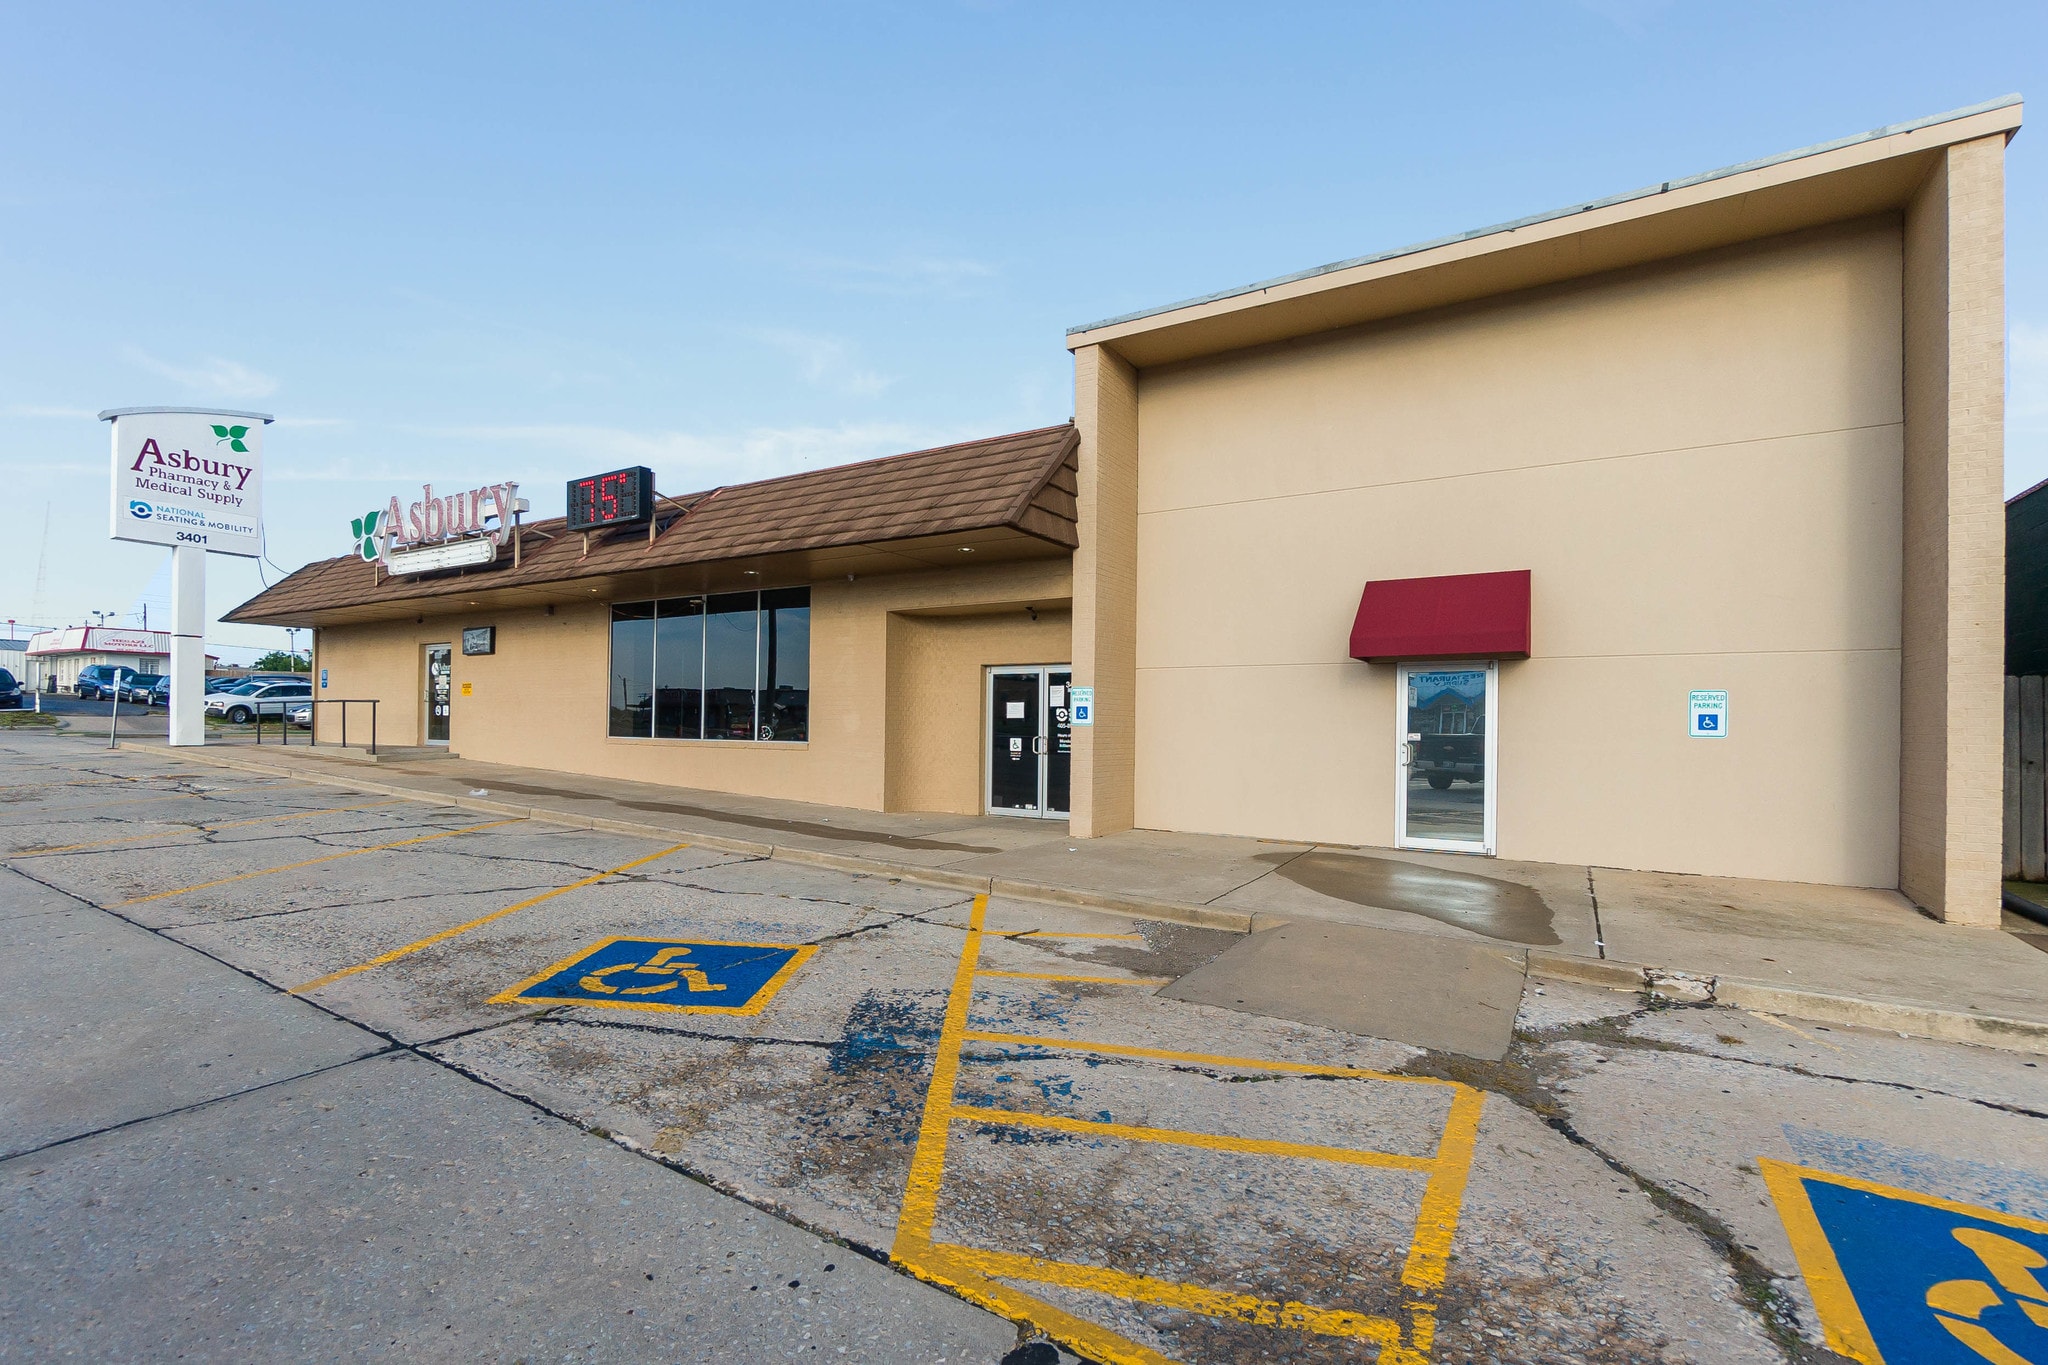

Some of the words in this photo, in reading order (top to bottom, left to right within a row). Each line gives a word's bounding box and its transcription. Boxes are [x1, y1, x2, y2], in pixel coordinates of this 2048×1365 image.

[130, 438, 253, 490] Asbury
[149, 467, 219, 490] Pharmacy
[223, 481, 232, 491] &
[135, 477, 192, 496] Medical
[197, 489, 243, 507] Supply
[156, 505, 206, 519] NATIONAL
[156, 513, 198, 526] SEATING
[208, 522, 254, 534] MOBILITY
[378, 481, 520, 567] Asbury
[176, 531, 208, 544] 3401
